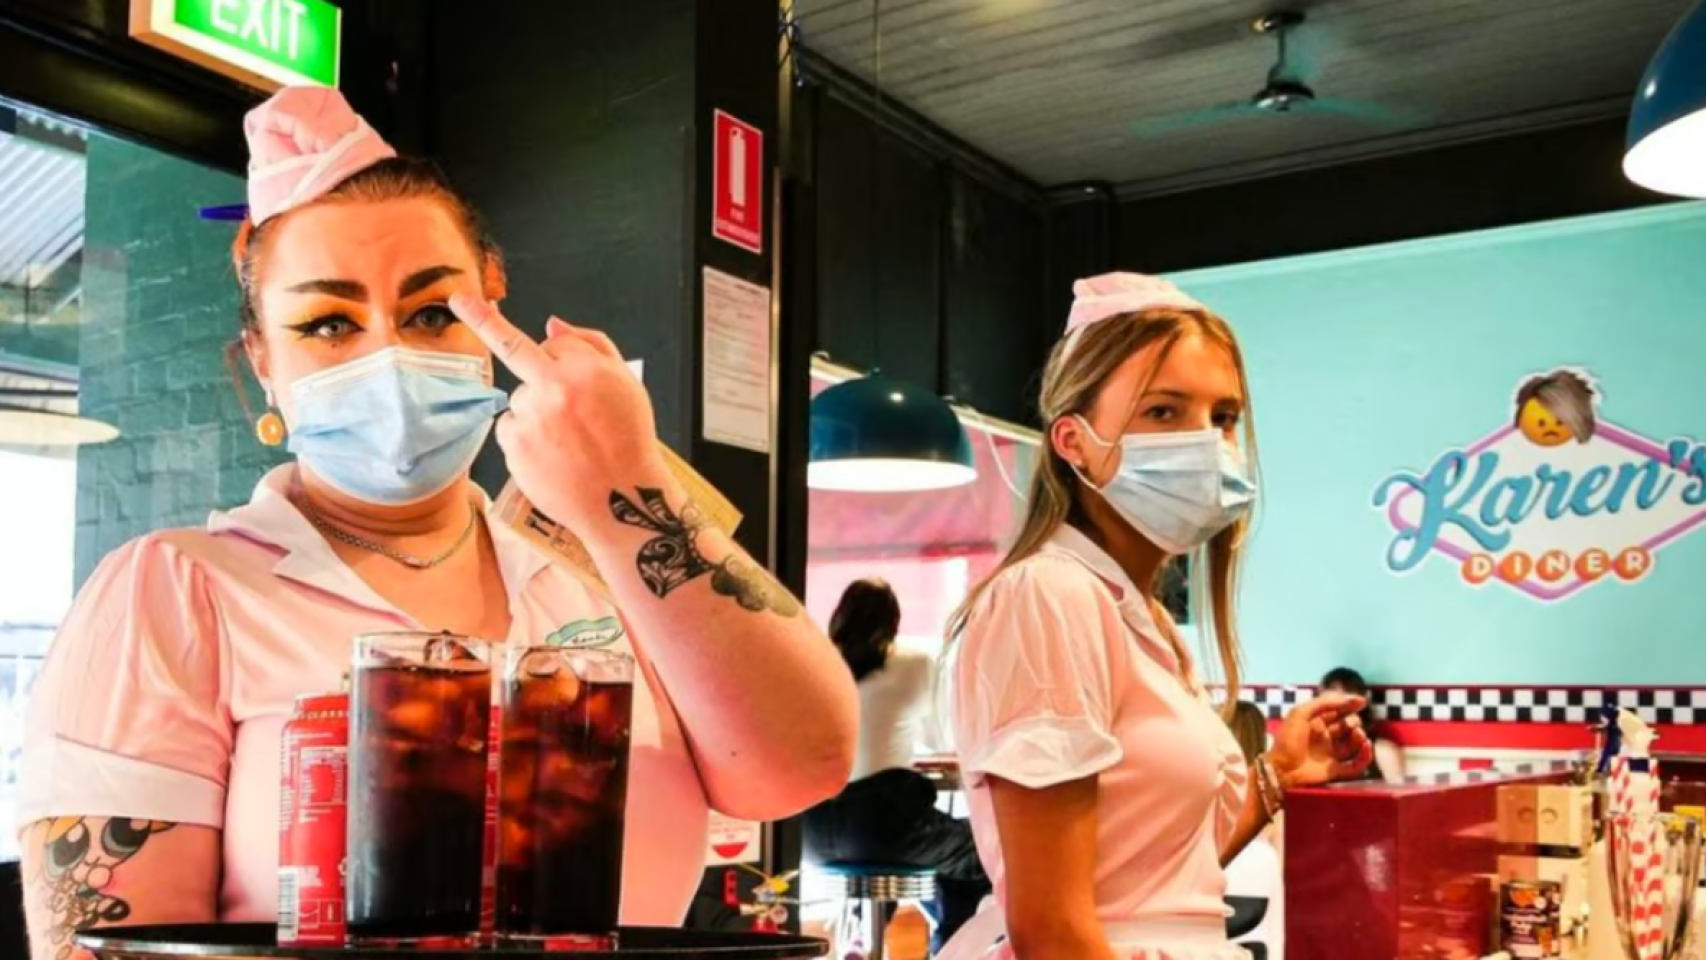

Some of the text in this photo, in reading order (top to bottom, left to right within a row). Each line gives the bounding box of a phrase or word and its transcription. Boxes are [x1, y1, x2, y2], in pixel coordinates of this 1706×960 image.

[209, 0, 308, 60] EXIT
[1372, 440, 1706, 572] Karen's
[1469, 550, 1647, 578] DINER
